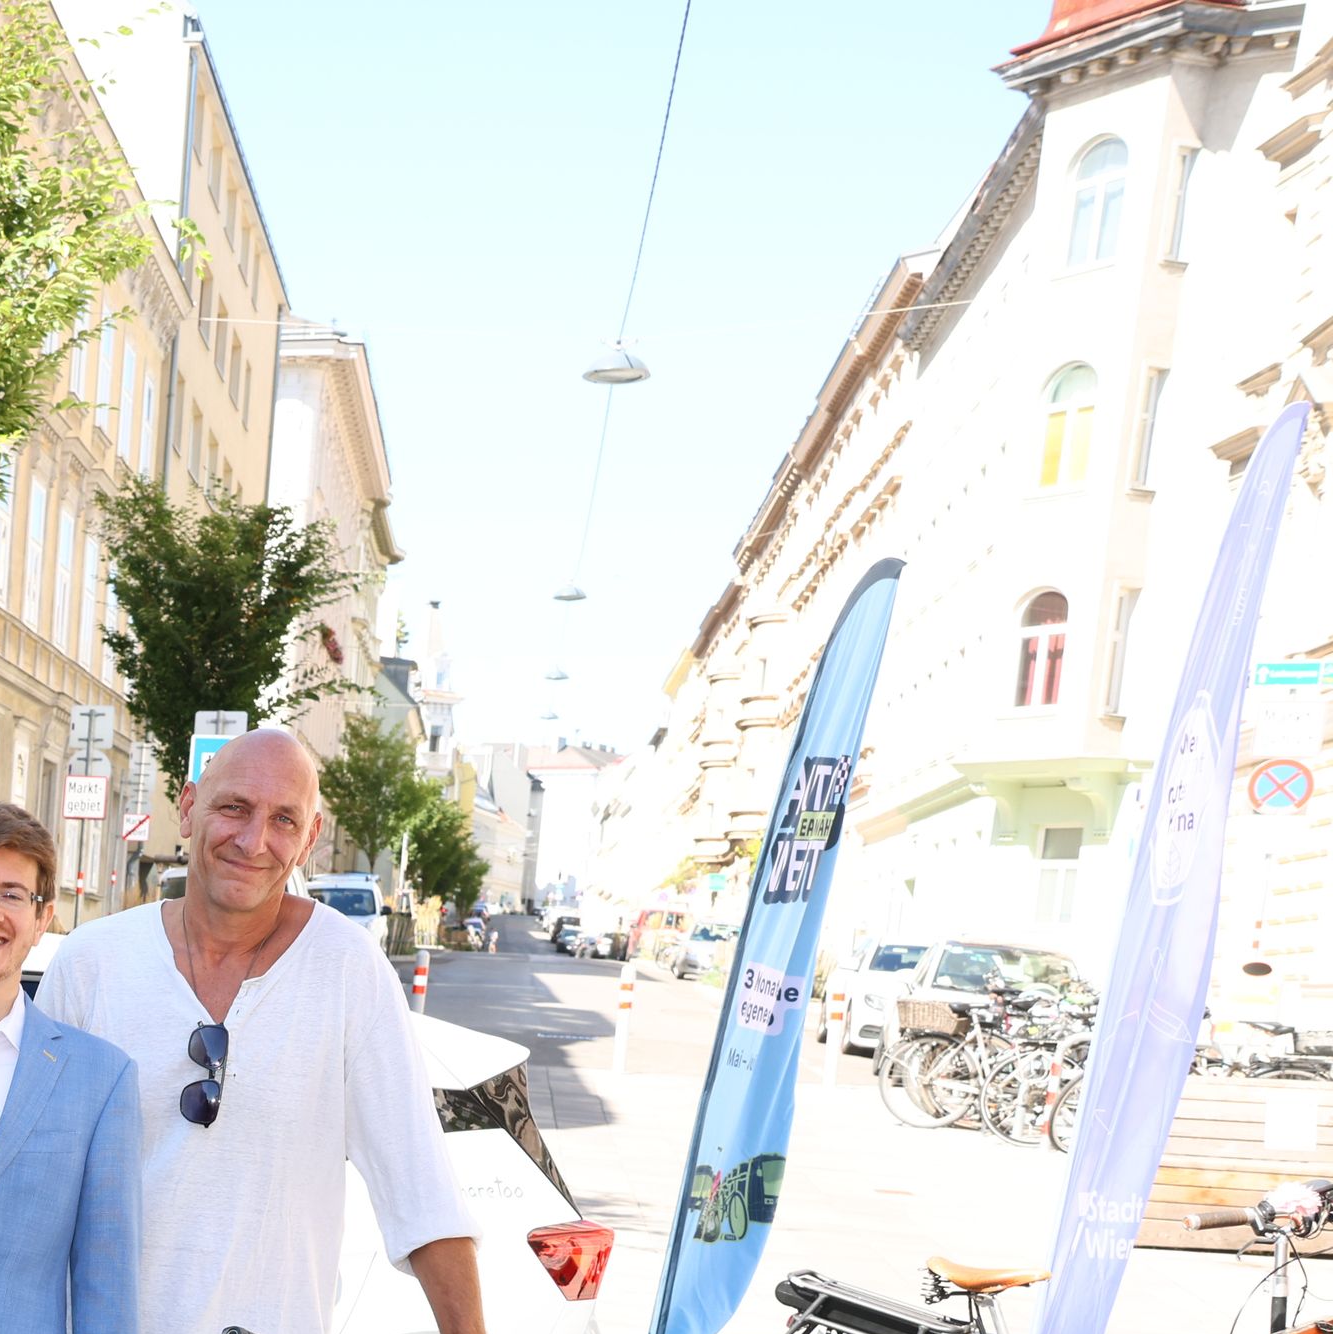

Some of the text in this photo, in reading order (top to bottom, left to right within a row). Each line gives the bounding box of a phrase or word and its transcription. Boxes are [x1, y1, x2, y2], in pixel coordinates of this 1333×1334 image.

[68, 782, 102, 794] Markt-
[67, 800, 101, 813] gebiet
[744, 968, 755, 989] 3
[1086, 1190, 1143, 1223] Stadt
